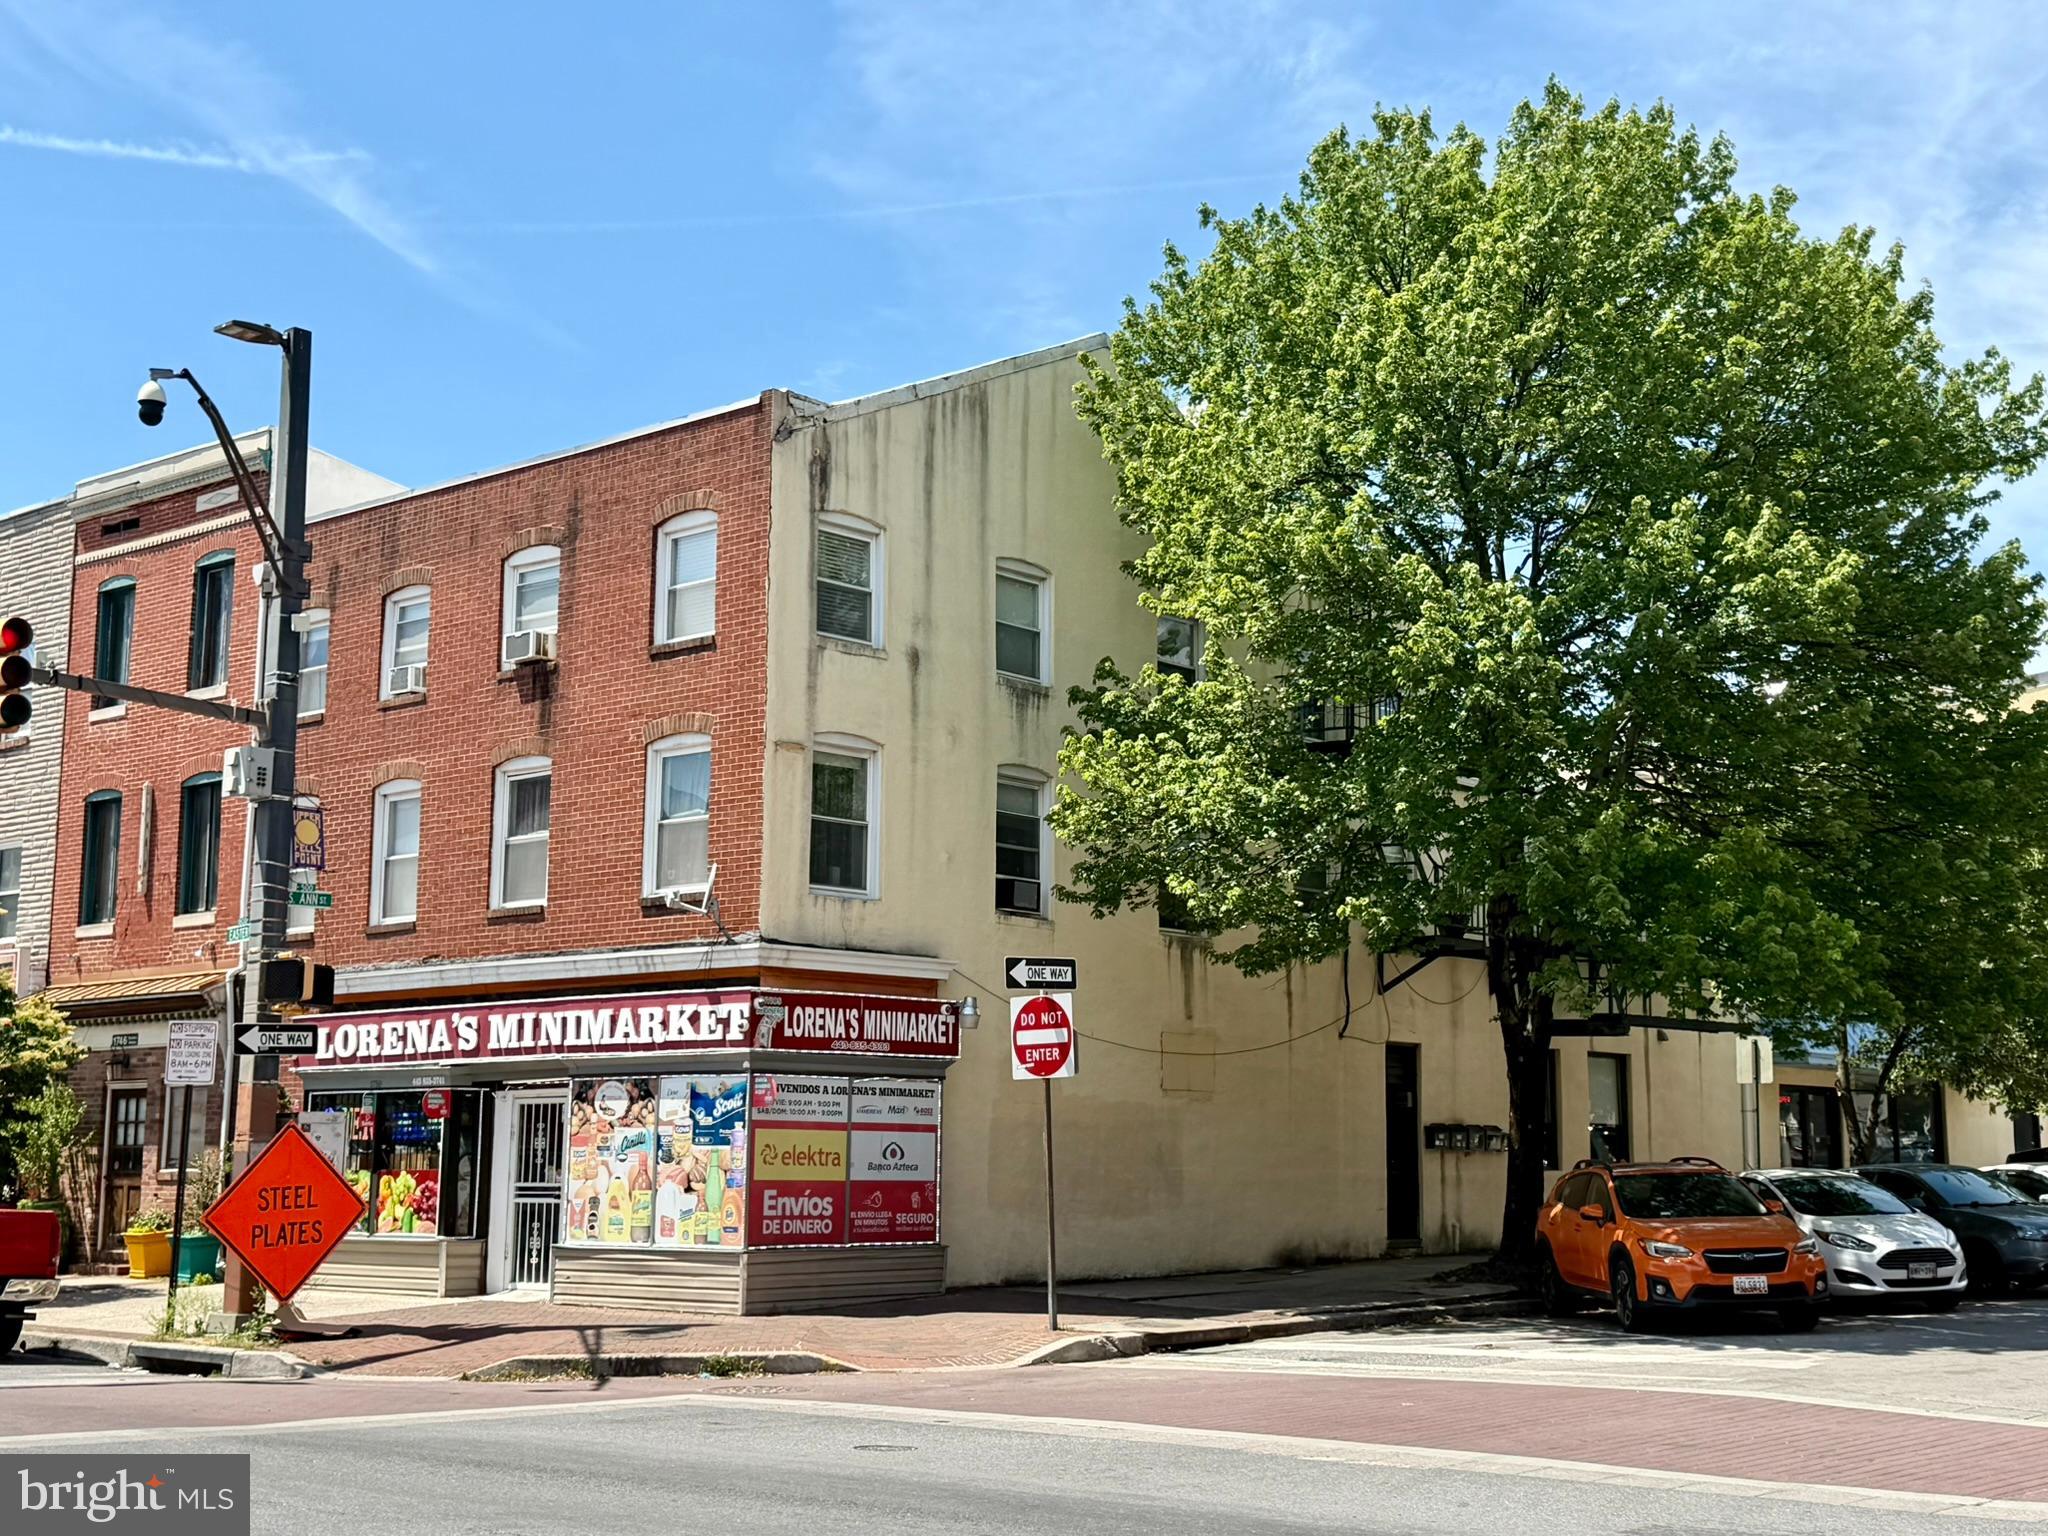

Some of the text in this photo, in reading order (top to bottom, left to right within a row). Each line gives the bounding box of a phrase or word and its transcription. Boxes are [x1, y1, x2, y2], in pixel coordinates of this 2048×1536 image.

[299, 894, 318, 904] ANN
[1027, 967, 1069, 980] ONE WAY
[783, 1006, 956, 1044] LORENA'S MINIMARKET
[1020, 1011, 1063, 1026] DO NOT
[171, 1024, 214, 1034] NO STOPPING
[315, 1001, 751, 1060] LORENA'S MINIMARKET
[170, 1040, 212, 1049] NO PARKING
[260, 1033, 309, 1045] ONE WAY
[1025, 1048, 1060, 1062] ENTER
[776, 1084, 820, 1094] VENIDOS
[822, 1085, 829, 1094] A
[879, 1087, 935, 1098] MINIMARKET
[713, 1091, 744, 1118] Scott
[781, 1144, 841, 1167] elektra
[867, 1162, 919, 1171] Banco Azteca
[257, 1185, 318, 1211] STEEL
[763, 1189, 833, 1216] Envíos
[896, 1213, 934, 1224] SEGURO
[251, 1220, 323, 1248] PLATES
[763, 1220, 832, 1234] DE DINERO
